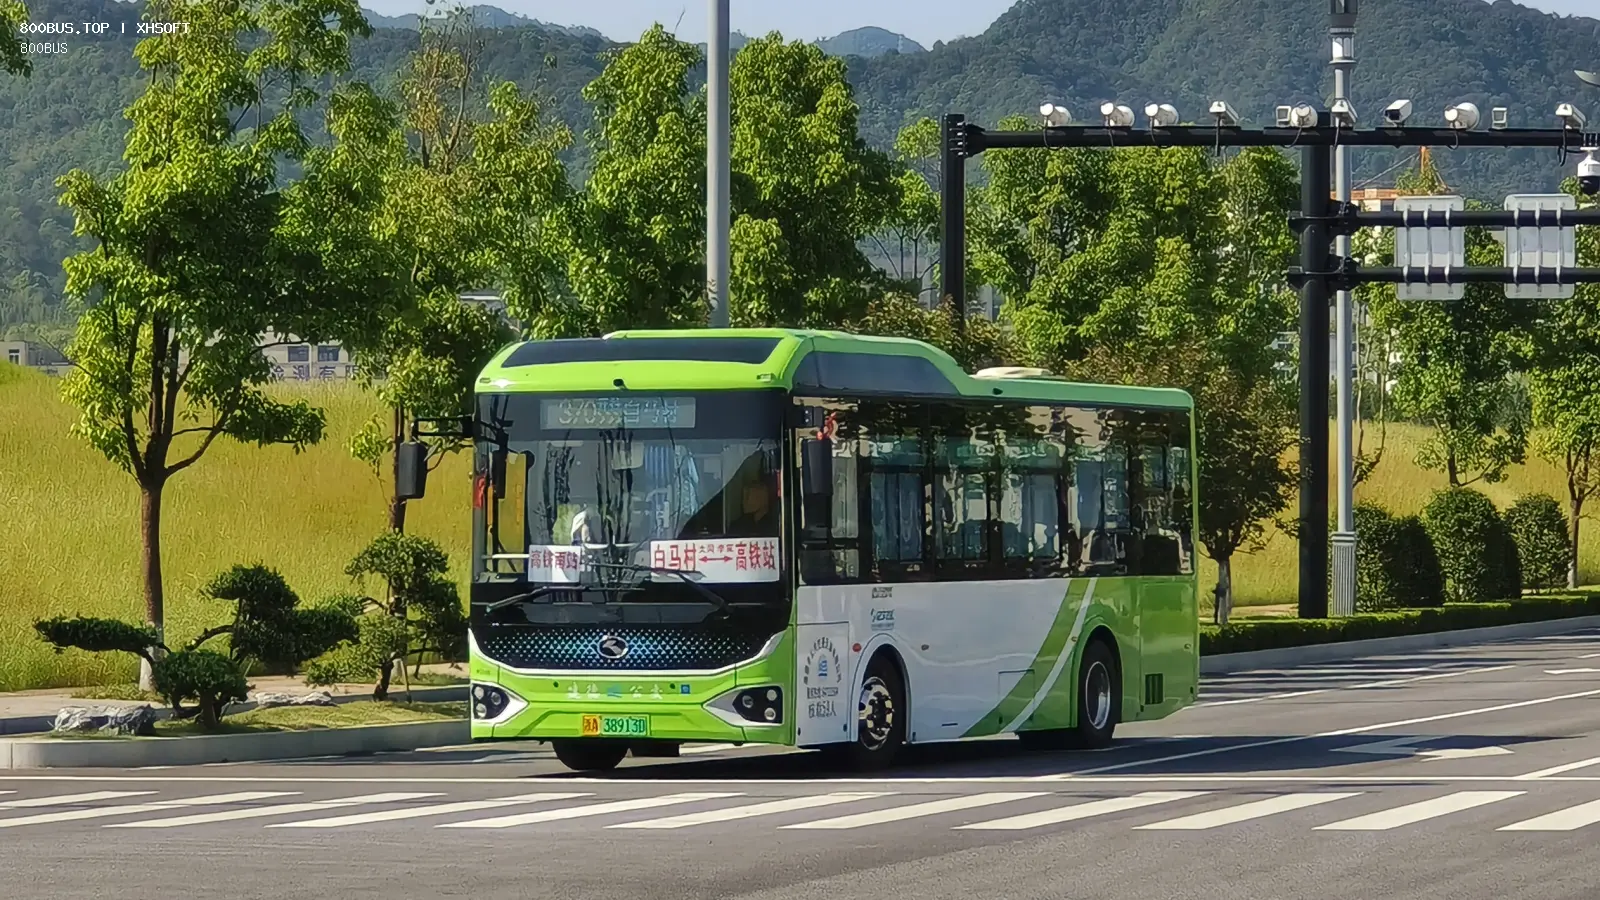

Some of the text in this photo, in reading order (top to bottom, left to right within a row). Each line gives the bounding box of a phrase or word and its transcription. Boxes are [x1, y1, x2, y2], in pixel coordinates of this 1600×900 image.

[653, 541, 777, 571] 白马村 高铁站
